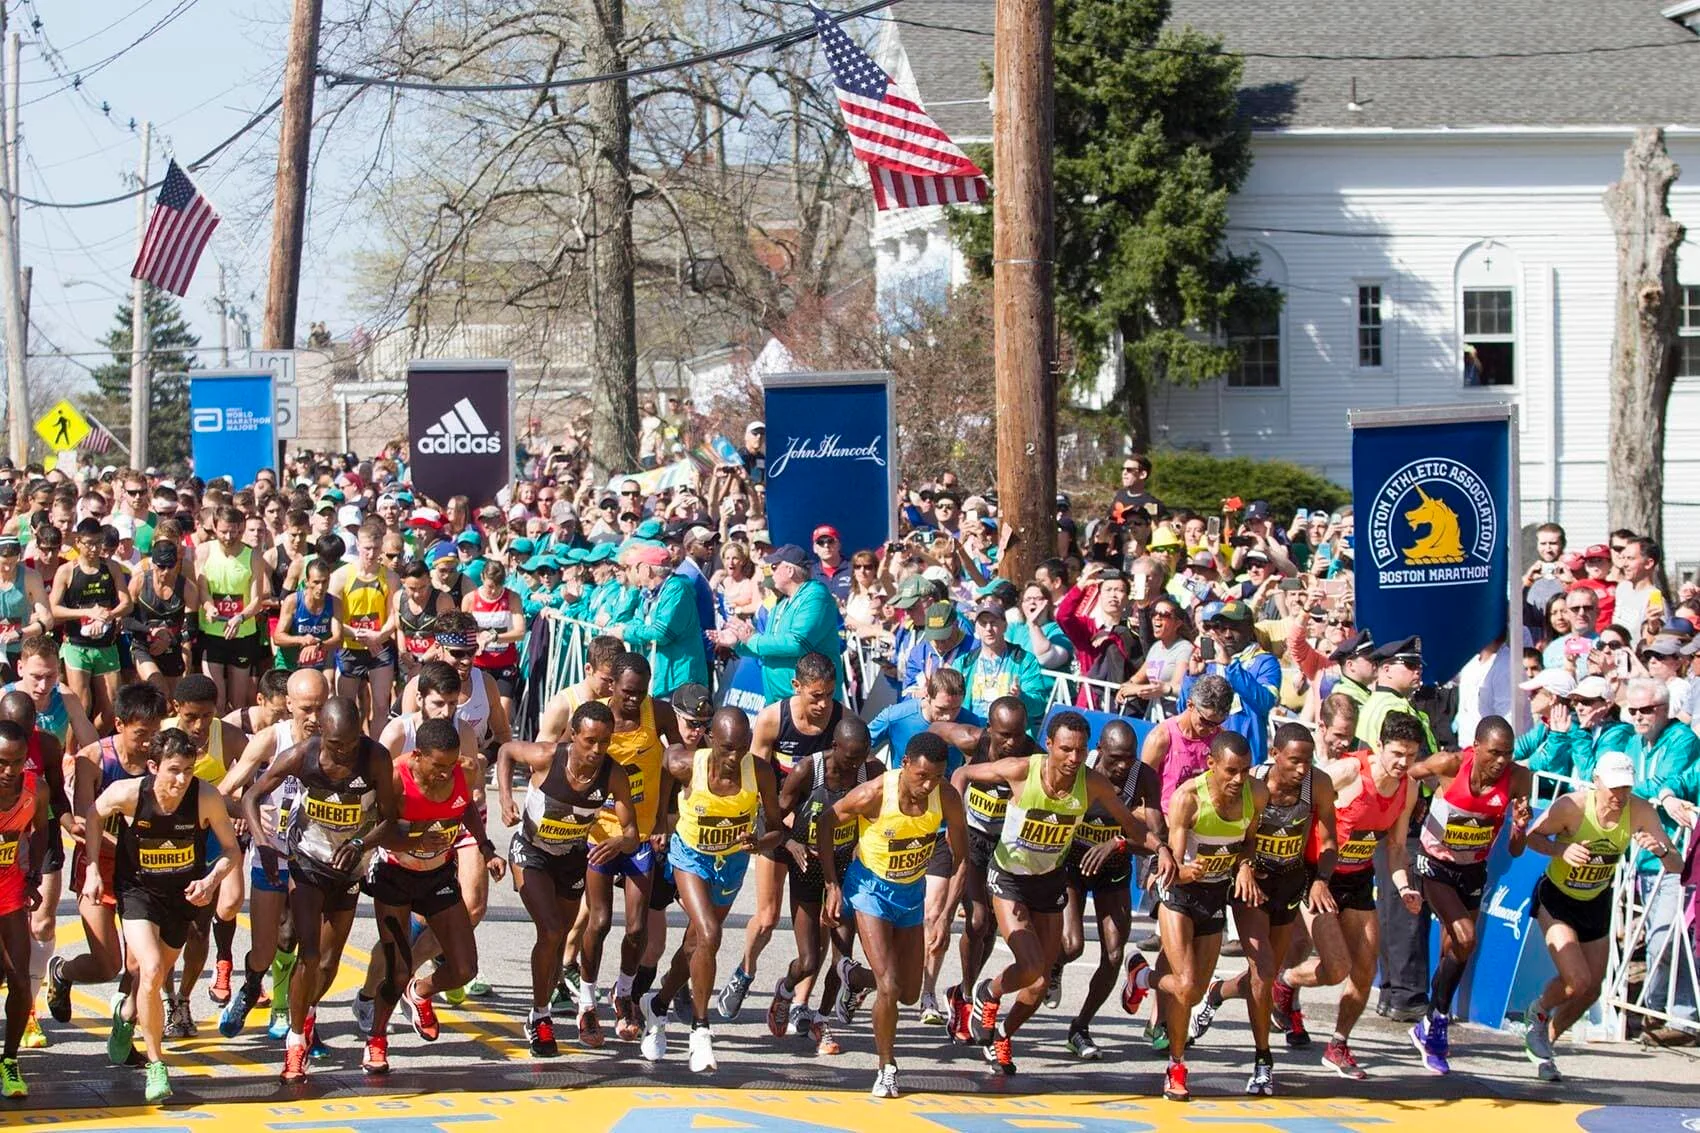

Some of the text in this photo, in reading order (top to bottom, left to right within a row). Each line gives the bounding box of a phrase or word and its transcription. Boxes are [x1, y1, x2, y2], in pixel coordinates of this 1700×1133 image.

[417, 433, 501, 454] adidas
[1026, 442, 1037, 456] 2
[768, 433, 886, 478] John Hancock
[1374, 463, 1493, 560] BOSTON ATHLETIC ASSOCIATION
[1379, 566, 1489, 584] BOSTON MARATHON
[217, 601, 239, 612] 129
[298, 624, 328, 633] BRASIL
[307, 802, 360, 823] CHEBET
[1019, 820, 1072, 844] HAYLE
[142, 850, 194, 865] BURRELL
[888, 844, 933, 870] DESISA
[267, 1095, 570, 1116] BOSTON
